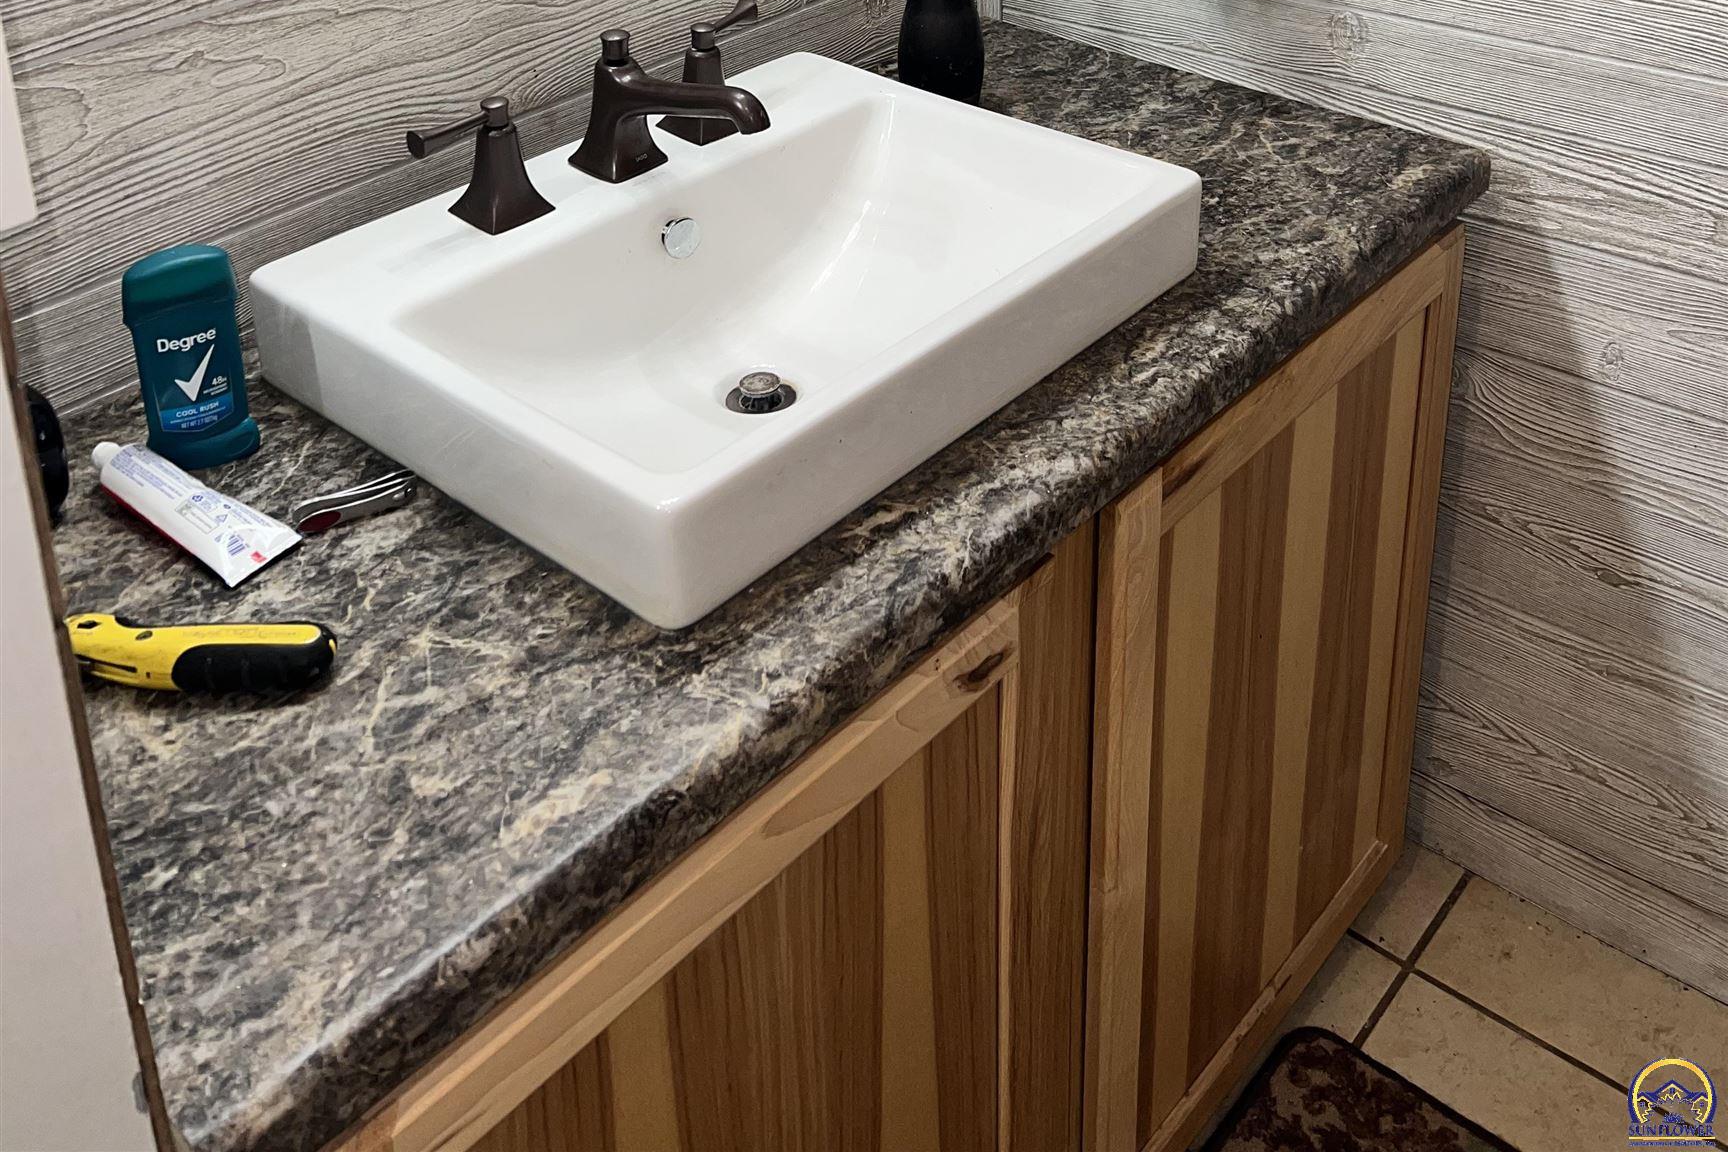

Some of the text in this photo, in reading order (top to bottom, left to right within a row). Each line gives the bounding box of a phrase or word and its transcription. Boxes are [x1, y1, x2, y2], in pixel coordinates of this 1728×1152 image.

[156, 328, 216, 352] Degree
[176, 401, 219, 418] COOL RUSH
